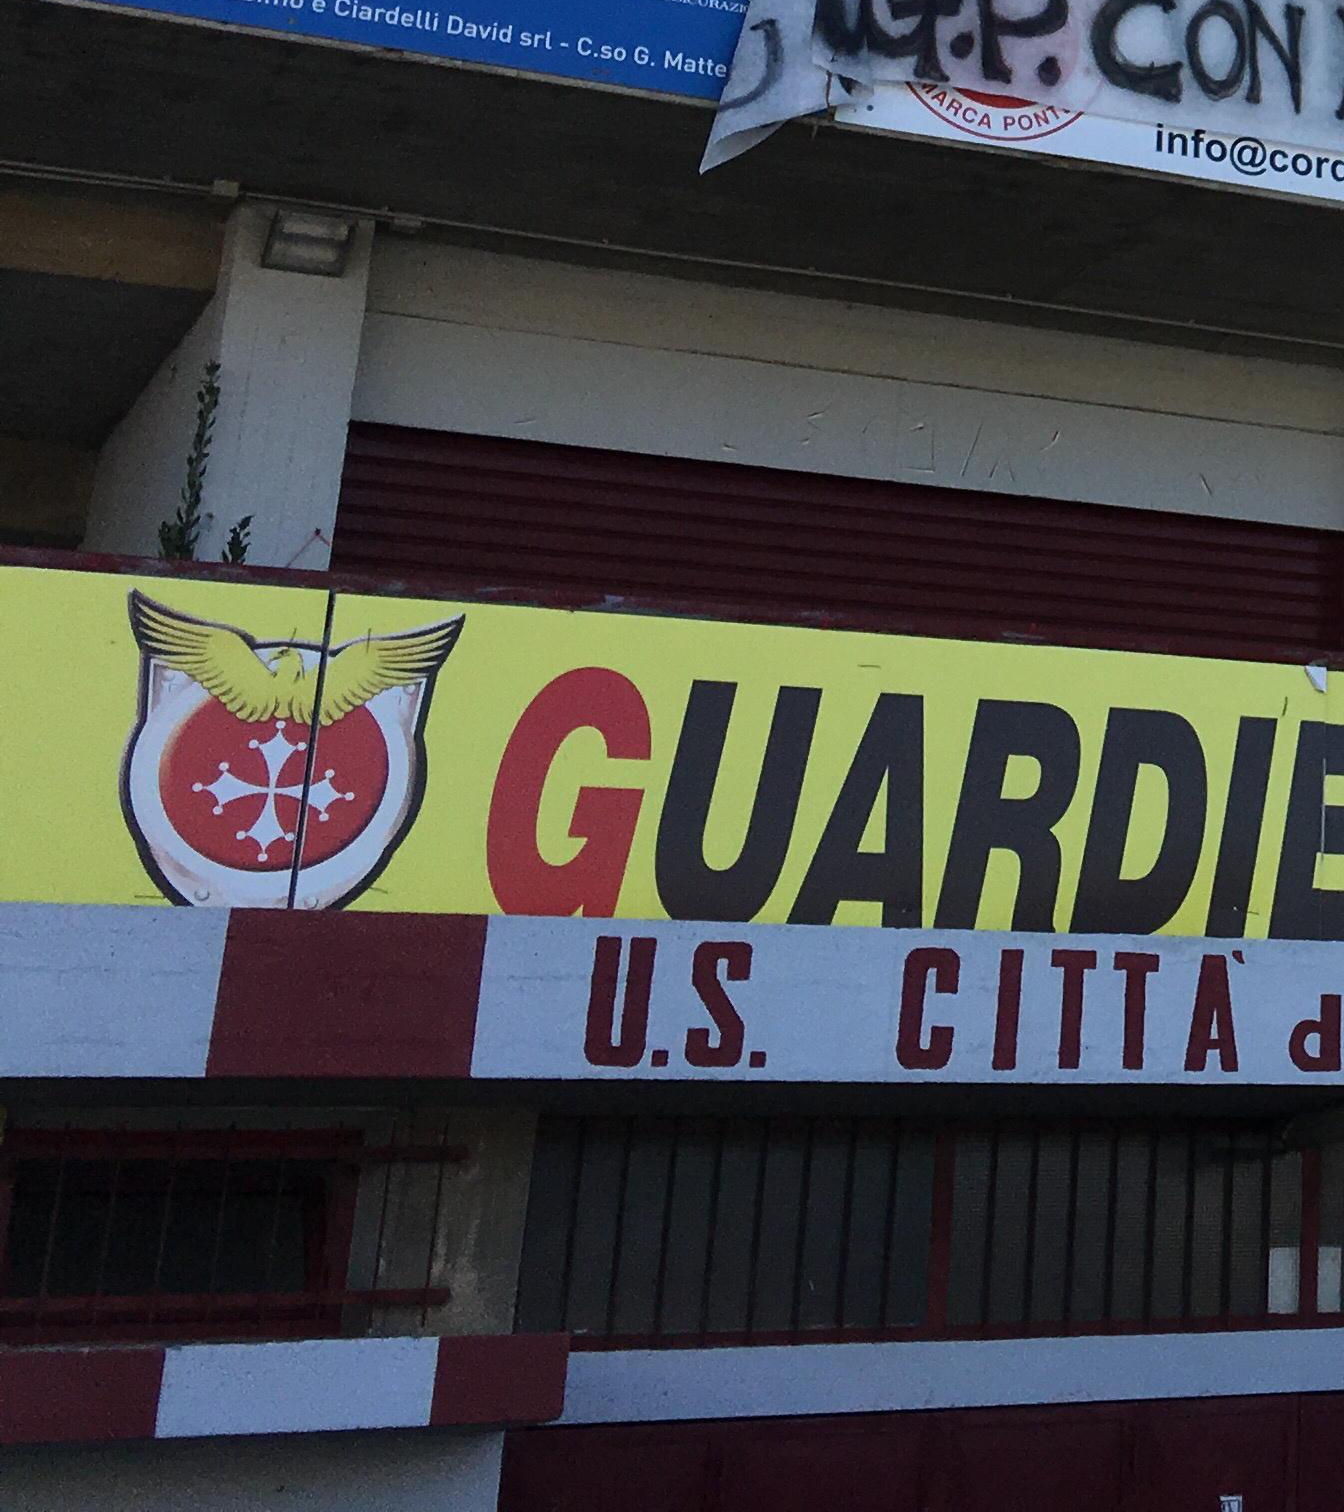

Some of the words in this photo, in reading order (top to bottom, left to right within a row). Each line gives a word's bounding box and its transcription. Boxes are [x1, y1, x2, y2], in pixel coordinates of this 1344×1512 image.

[446, 15, 513, 44] David
[519, 31, 552, 52] srl
[577, 38, 628, 63] C.so
[633, 46, 655, 68] G.
[1002, 105, 1071, 132] PONT
[584, 935, 766, 1070] U.S.
[895, 945, 1247, 1073] CITTÀ
